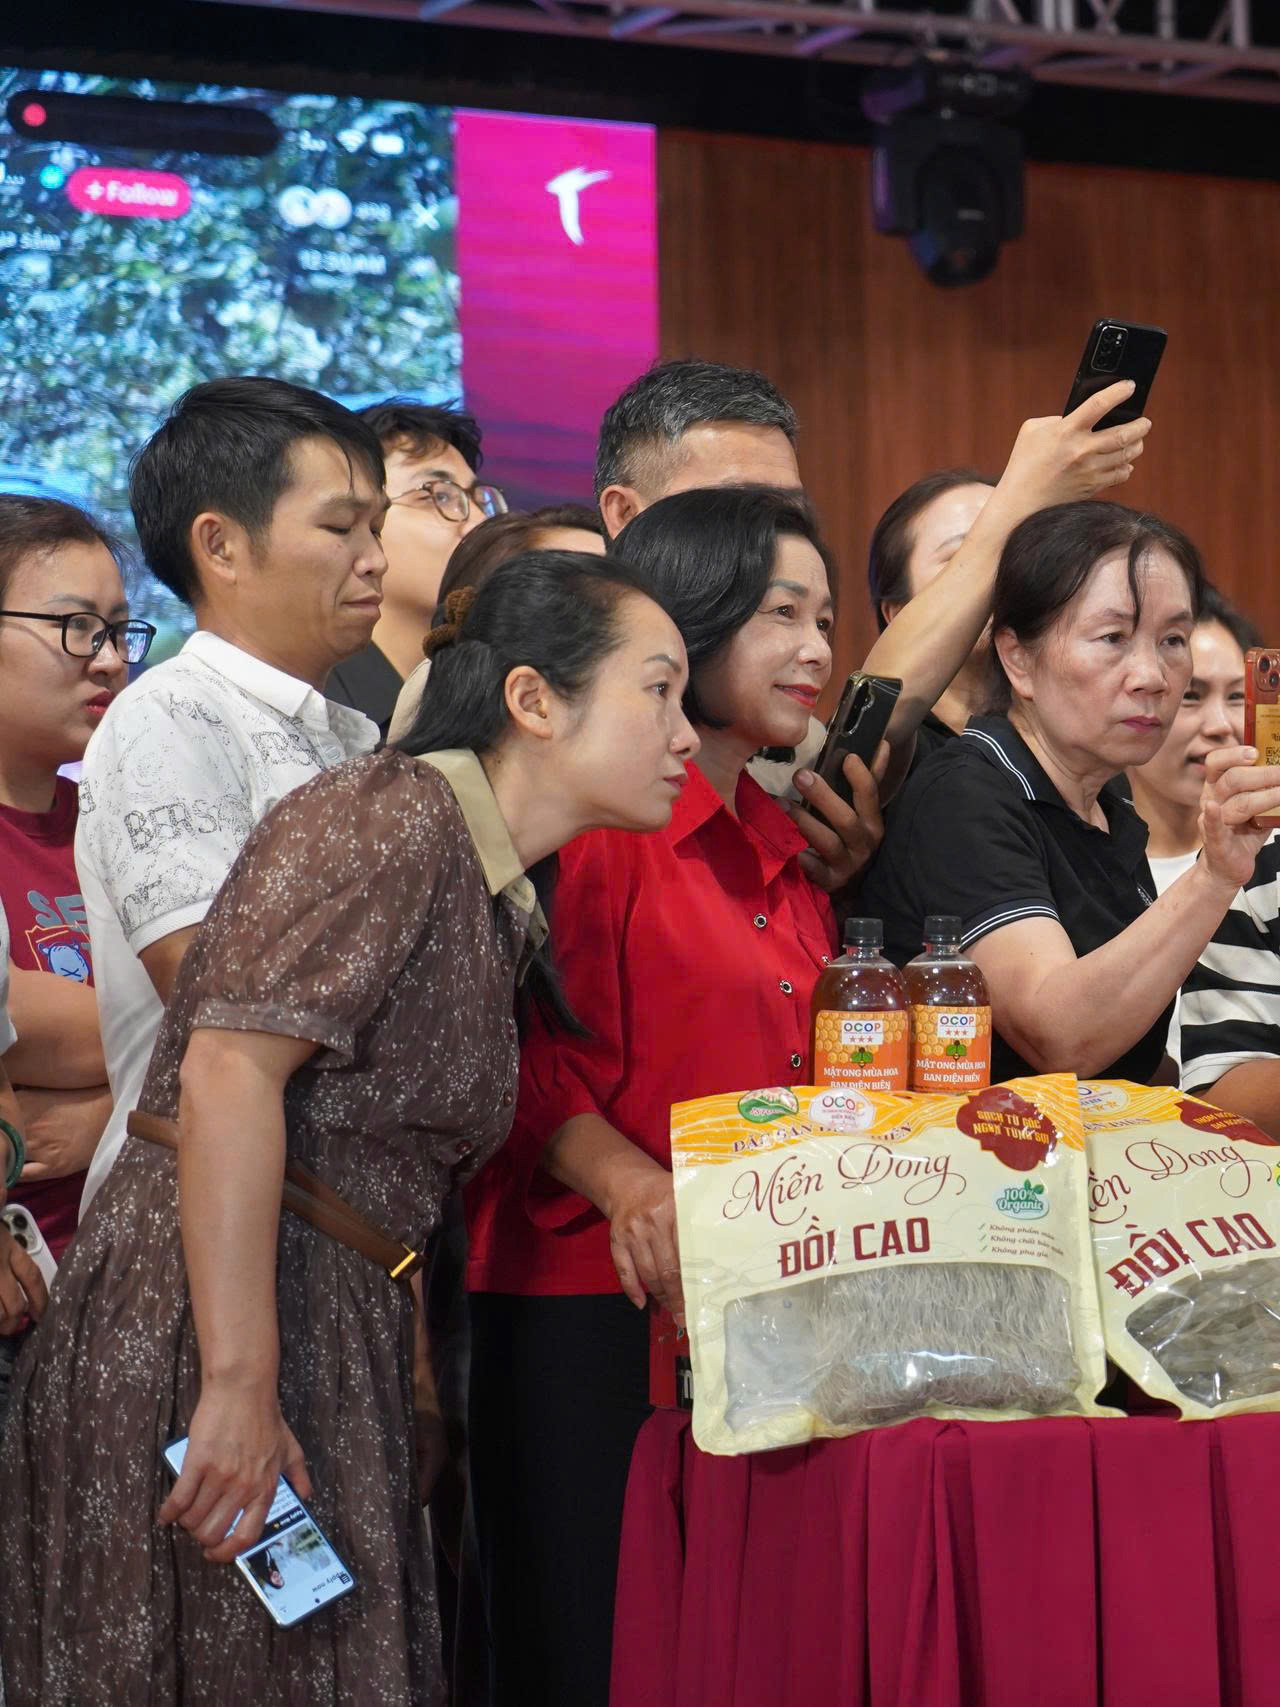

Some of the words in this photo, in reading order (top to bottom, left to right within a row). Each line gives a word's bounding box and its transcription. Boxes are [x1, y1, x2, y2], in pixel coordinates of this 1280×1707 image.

[107, 180, 179, 206] Follow
[843, 1022, 881, 1032] OCOP
[940, 1015, 975, 1025] OCOP
[823, 1066, 842, 1078] MẬT
[842, 1068, 861, 1077] ONG
[862, 1066, 882, 1077] MÙA
[883, 1067, 898, 1076] HOA
[837, 1142, 967, 1206] Dong
[1125, 1137, 1273, 1198] Dong
[1004, 1187, 1037, 1201] 100%
[996, 1199, 1044, 1214] Organic
[777, 1215, 838, 1279] ĐỒI
[852, 1217, 931, 1261] CAO
[1105, 1223, 1195, 1299] ĐỒI
[1184, 1212, 1277, 1258] CAO
